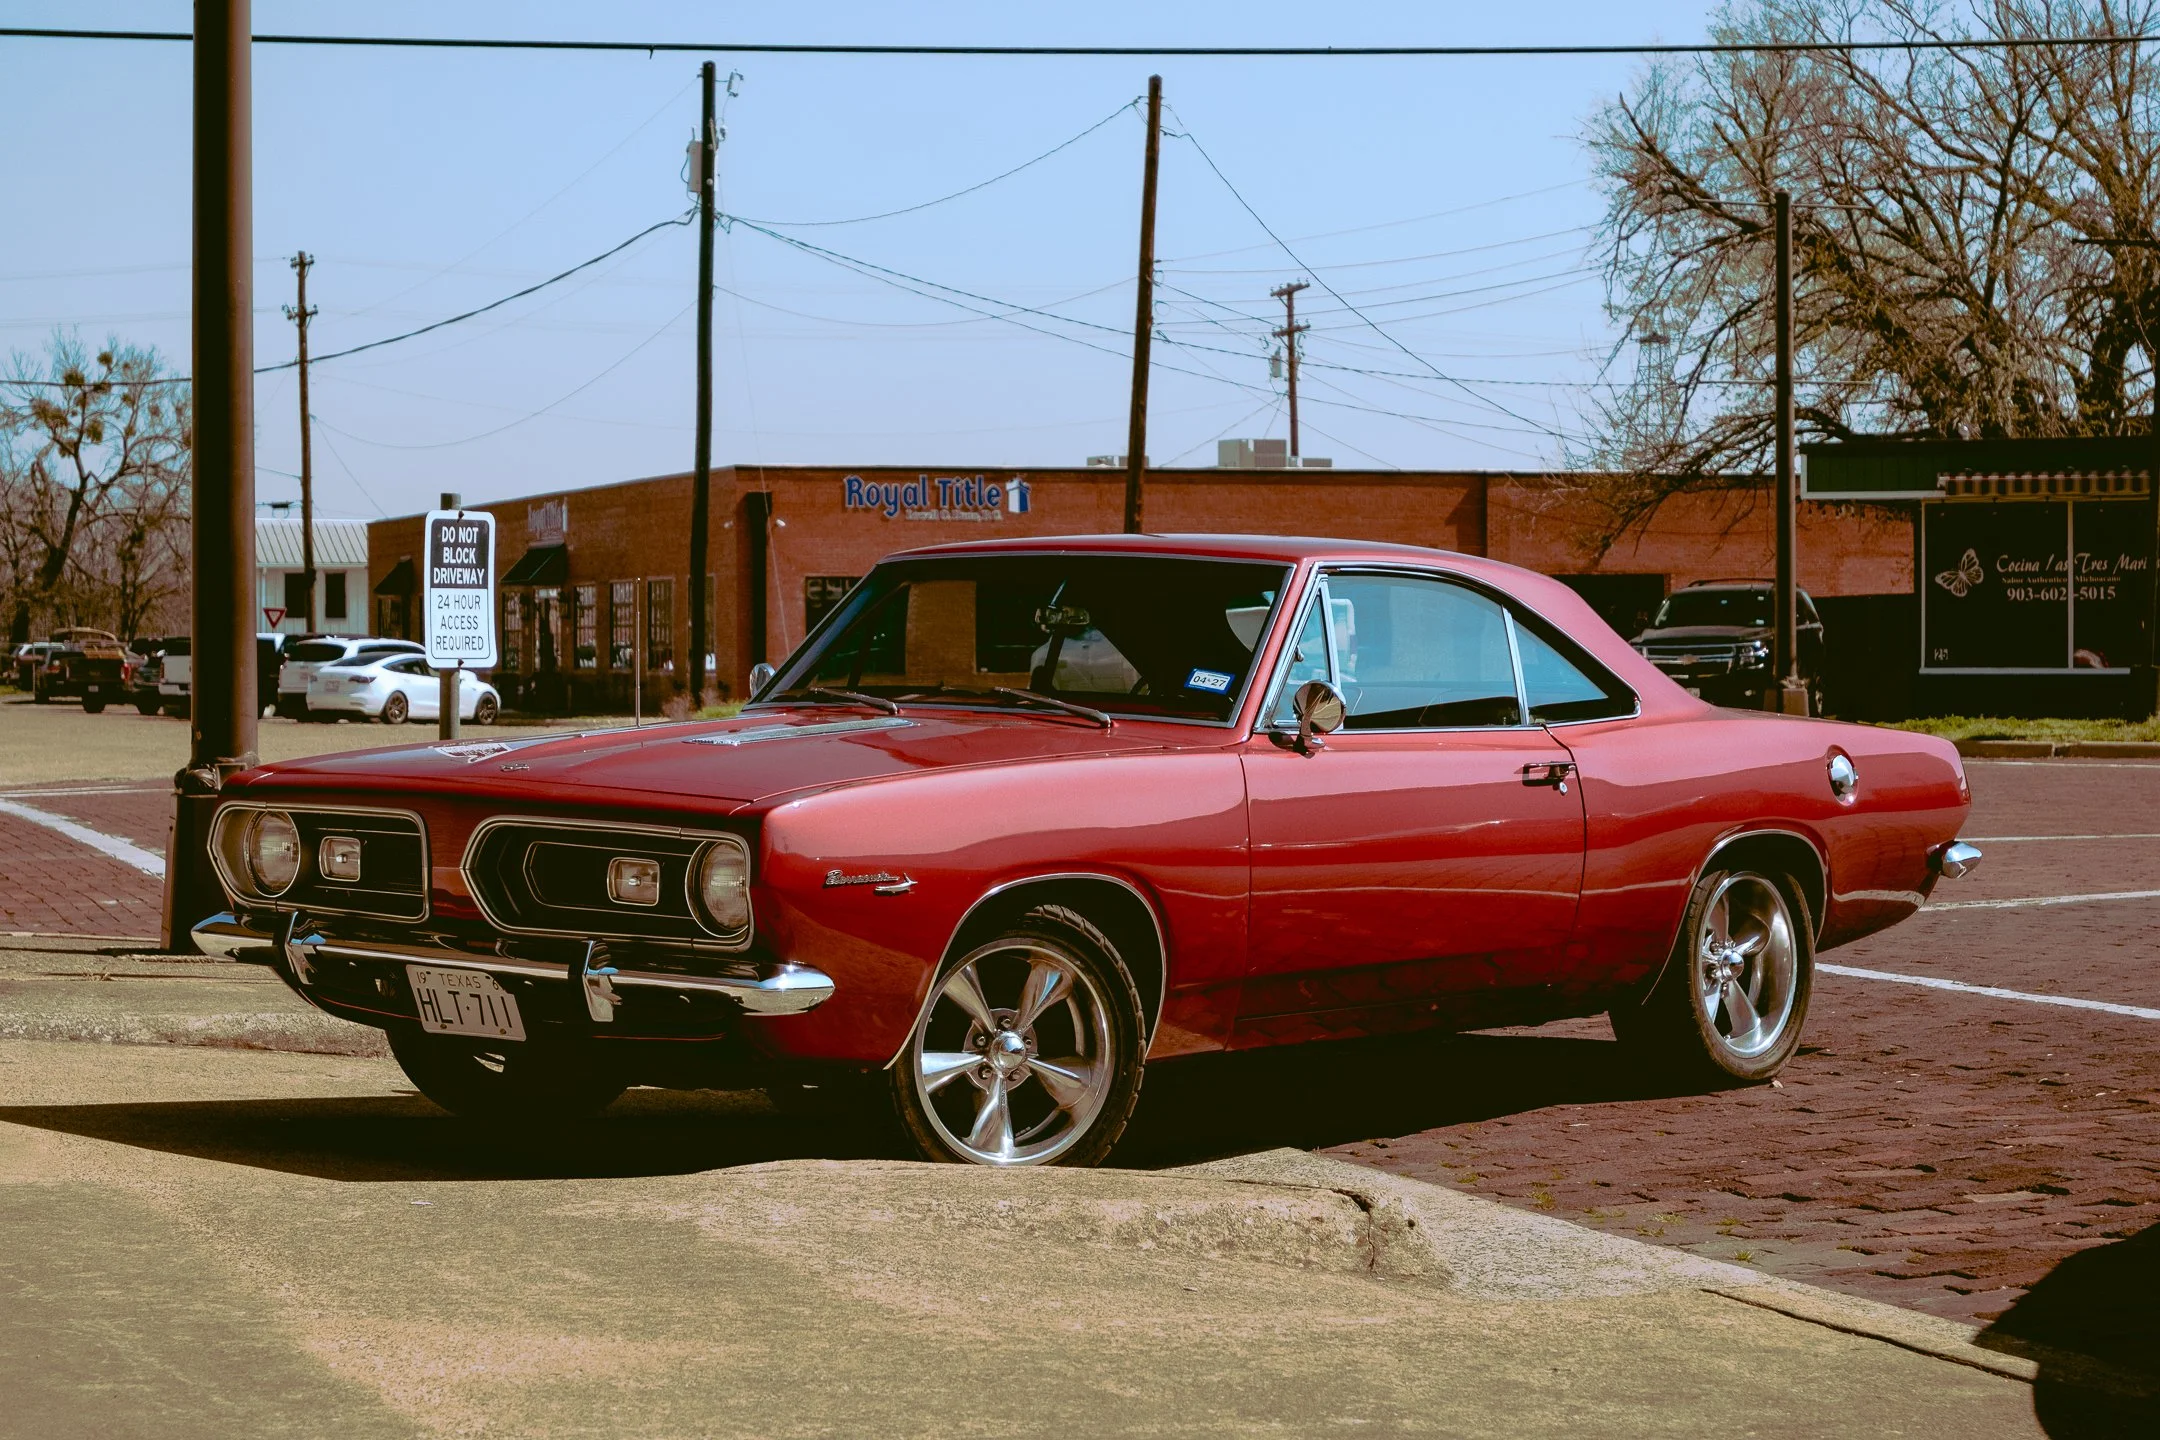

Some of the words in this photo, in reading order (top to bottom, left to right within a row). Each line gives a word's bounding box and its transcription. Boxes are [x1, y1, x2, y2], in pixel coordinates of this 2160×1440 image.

[843, 474, 930, 518] Royal
[935, 474, 1002, 509] Title
[441, 526, 456, 544] DO
[458, 526, 479, 544] NOT
[443, 547, 476, 564] BLOCK
[1996, 555, 2040, 573] Cocina
[2074, 553, 2108, 574] Tres
[2112, 552, 2148, 575] Mari
[433, 567, 485, 585] DRIVEWAY
[437, 594, 450, 610] 24
[454, 594, 481, 610] HOUR
[2006, 586, 2117, 601] 903-602-5015
[440, 615, 479, 630] ACCESS
[435, 635, 484, 651] REQUIRED
[1193, 675, 1207, 684] 04
[1210, 678, 1227, 687] 27
[416, 971, 427, 984] 19
[438, 973, 481, 989] TEXAS
[492, 979, 500, 991] 6
